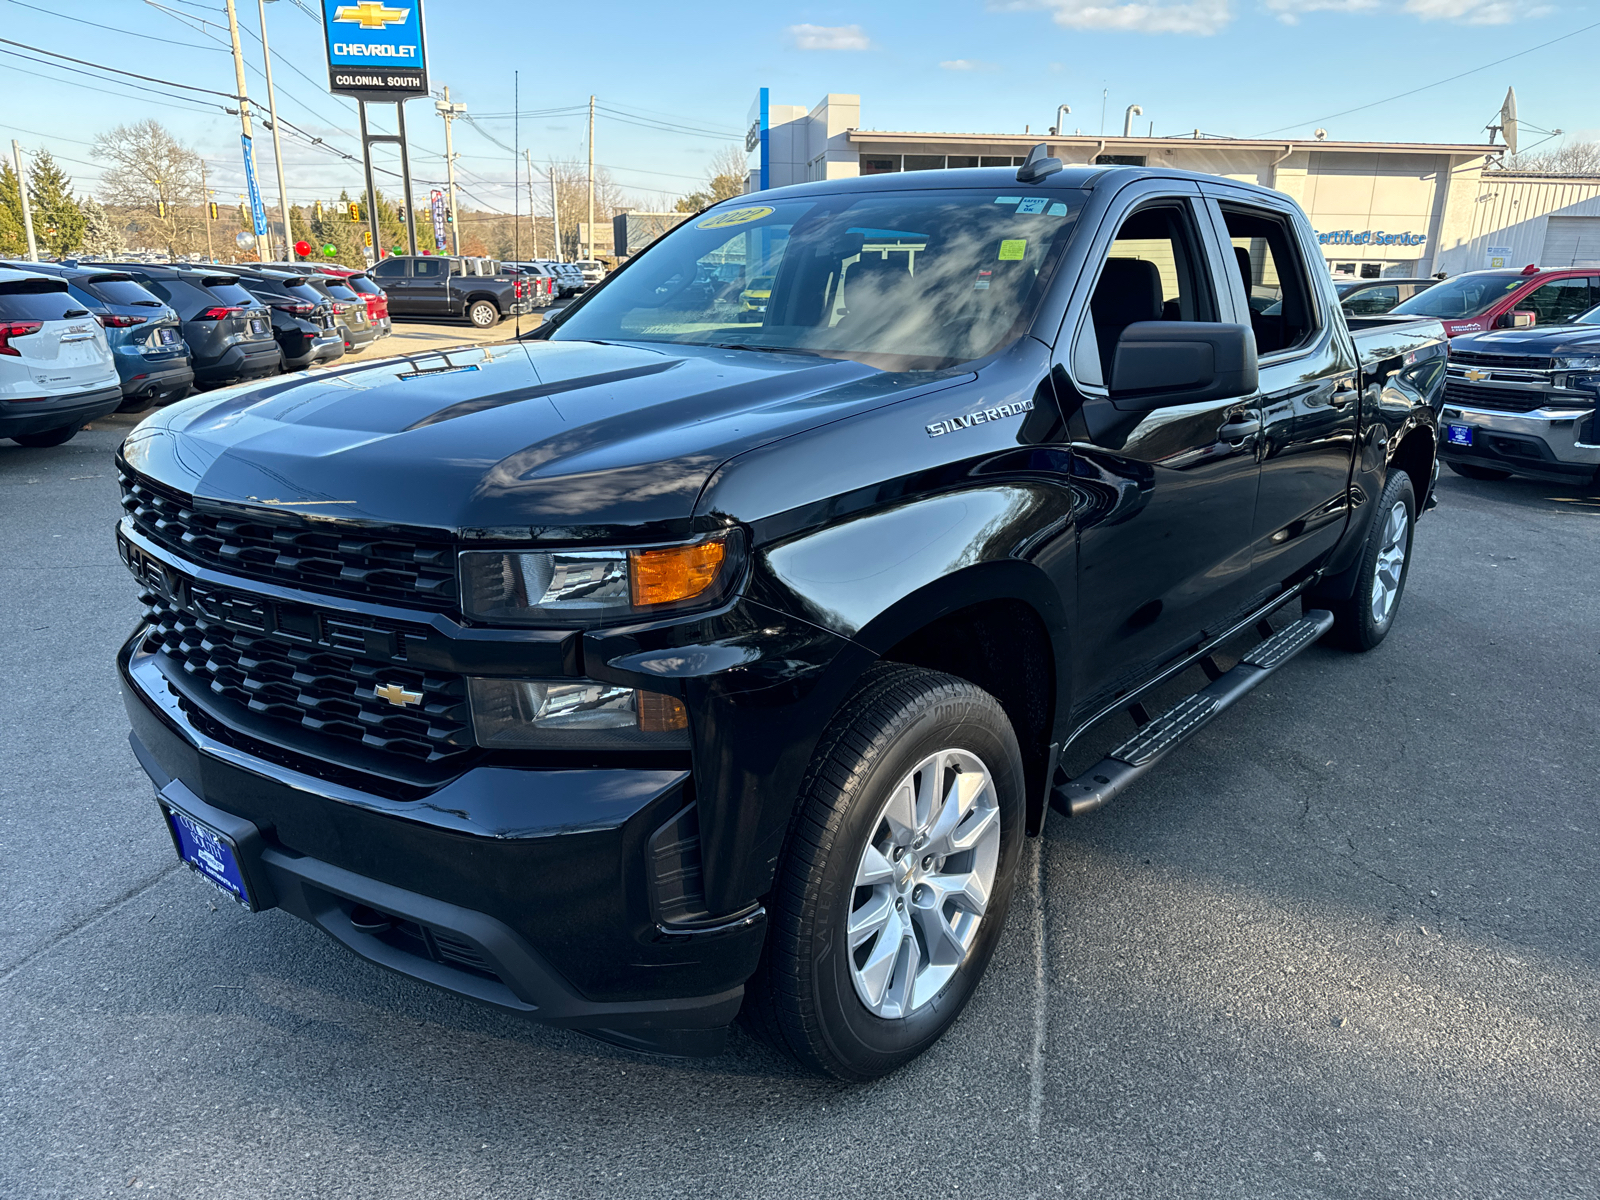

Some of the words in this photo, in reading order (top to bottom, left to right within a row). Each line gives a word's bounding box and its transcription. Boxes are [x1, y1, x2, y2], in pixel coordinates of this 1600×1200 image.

[333, 43, 416, 57] CHEVROLET
[335, 75, 385, 86] COLONIAL
[387, 76, 420, 87] SOUTH
[703, 208, 765, 228] 2022
[1314, 229, 1371, 245] ertified
[1375, 231, 1427, 245] Service
[926, 399, 1035, 438] SILVERADO
[119, 538, 428, 662] CHEVROLET
[180, 815, 225, 852] COLONIAL
[191, 831, 223, 861] SOUTH
[816, 846, 846, 942] ALENZA
